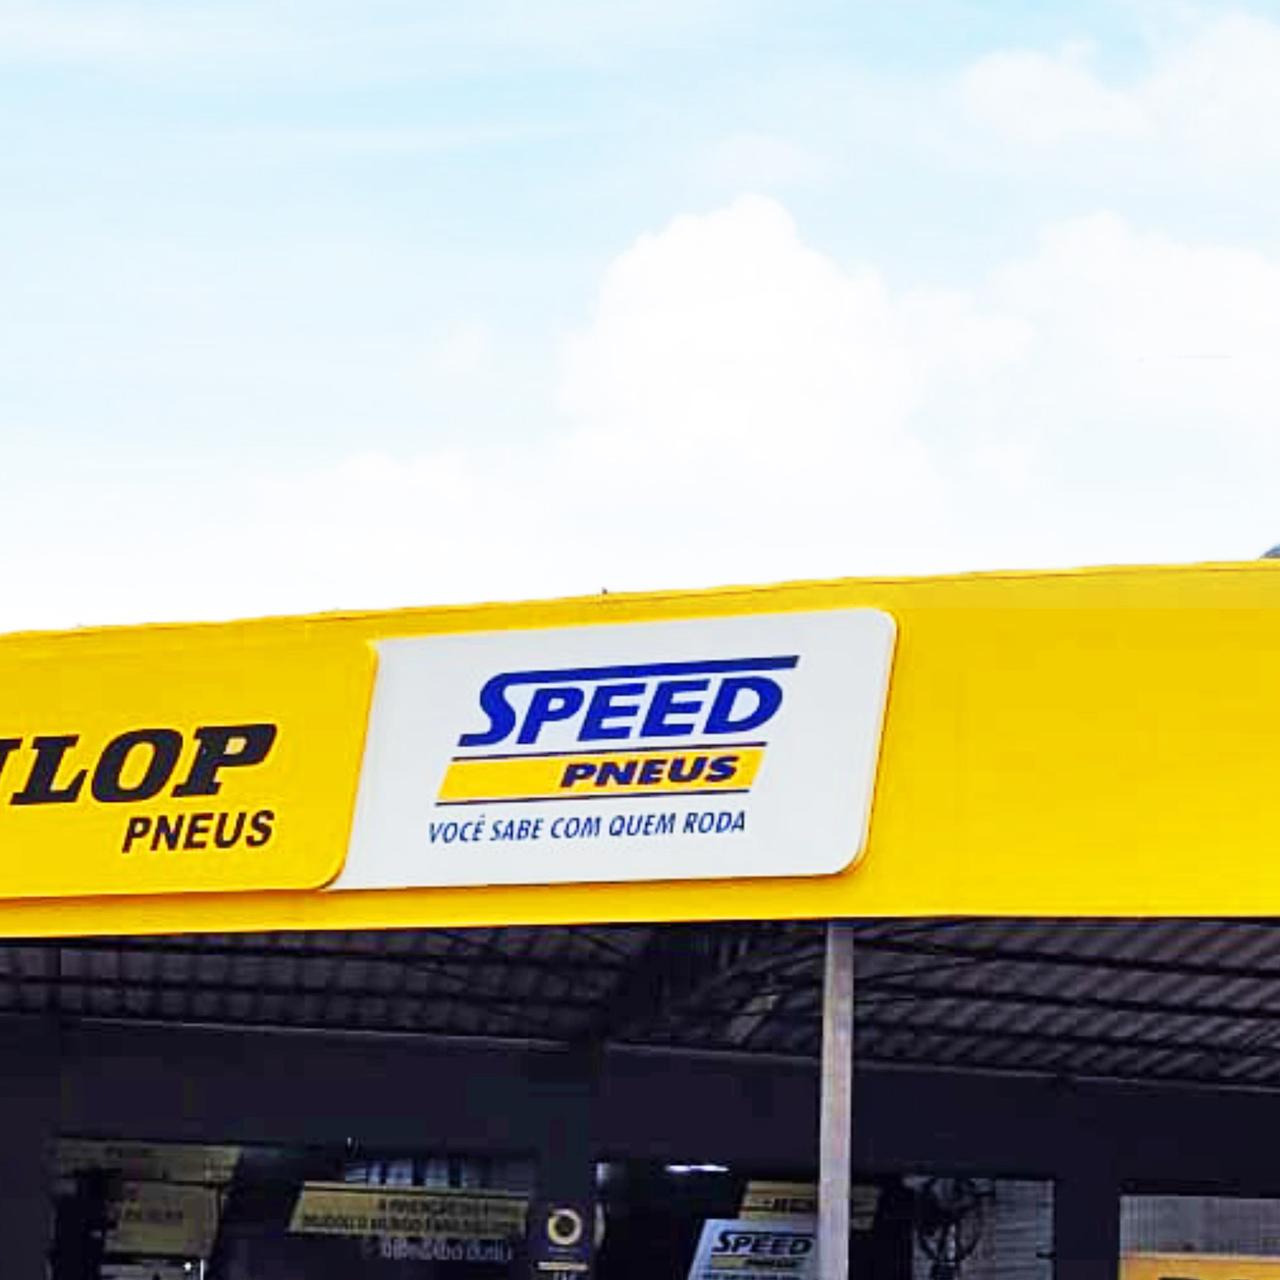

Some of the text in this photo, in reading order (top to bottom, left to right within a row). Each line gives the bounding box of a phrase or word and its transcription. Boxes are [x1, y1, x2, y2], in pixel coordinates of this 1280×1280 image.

[458, 655, 800, 747] SPEED
[560, 755, 739, 788] PNEUS
[121, 810, 276, 853] PNEUS
[428, 810, 747, 843] VOCÊ SABE COM QUEM RODA
[712, 1231, 814, 1254] SPEED
